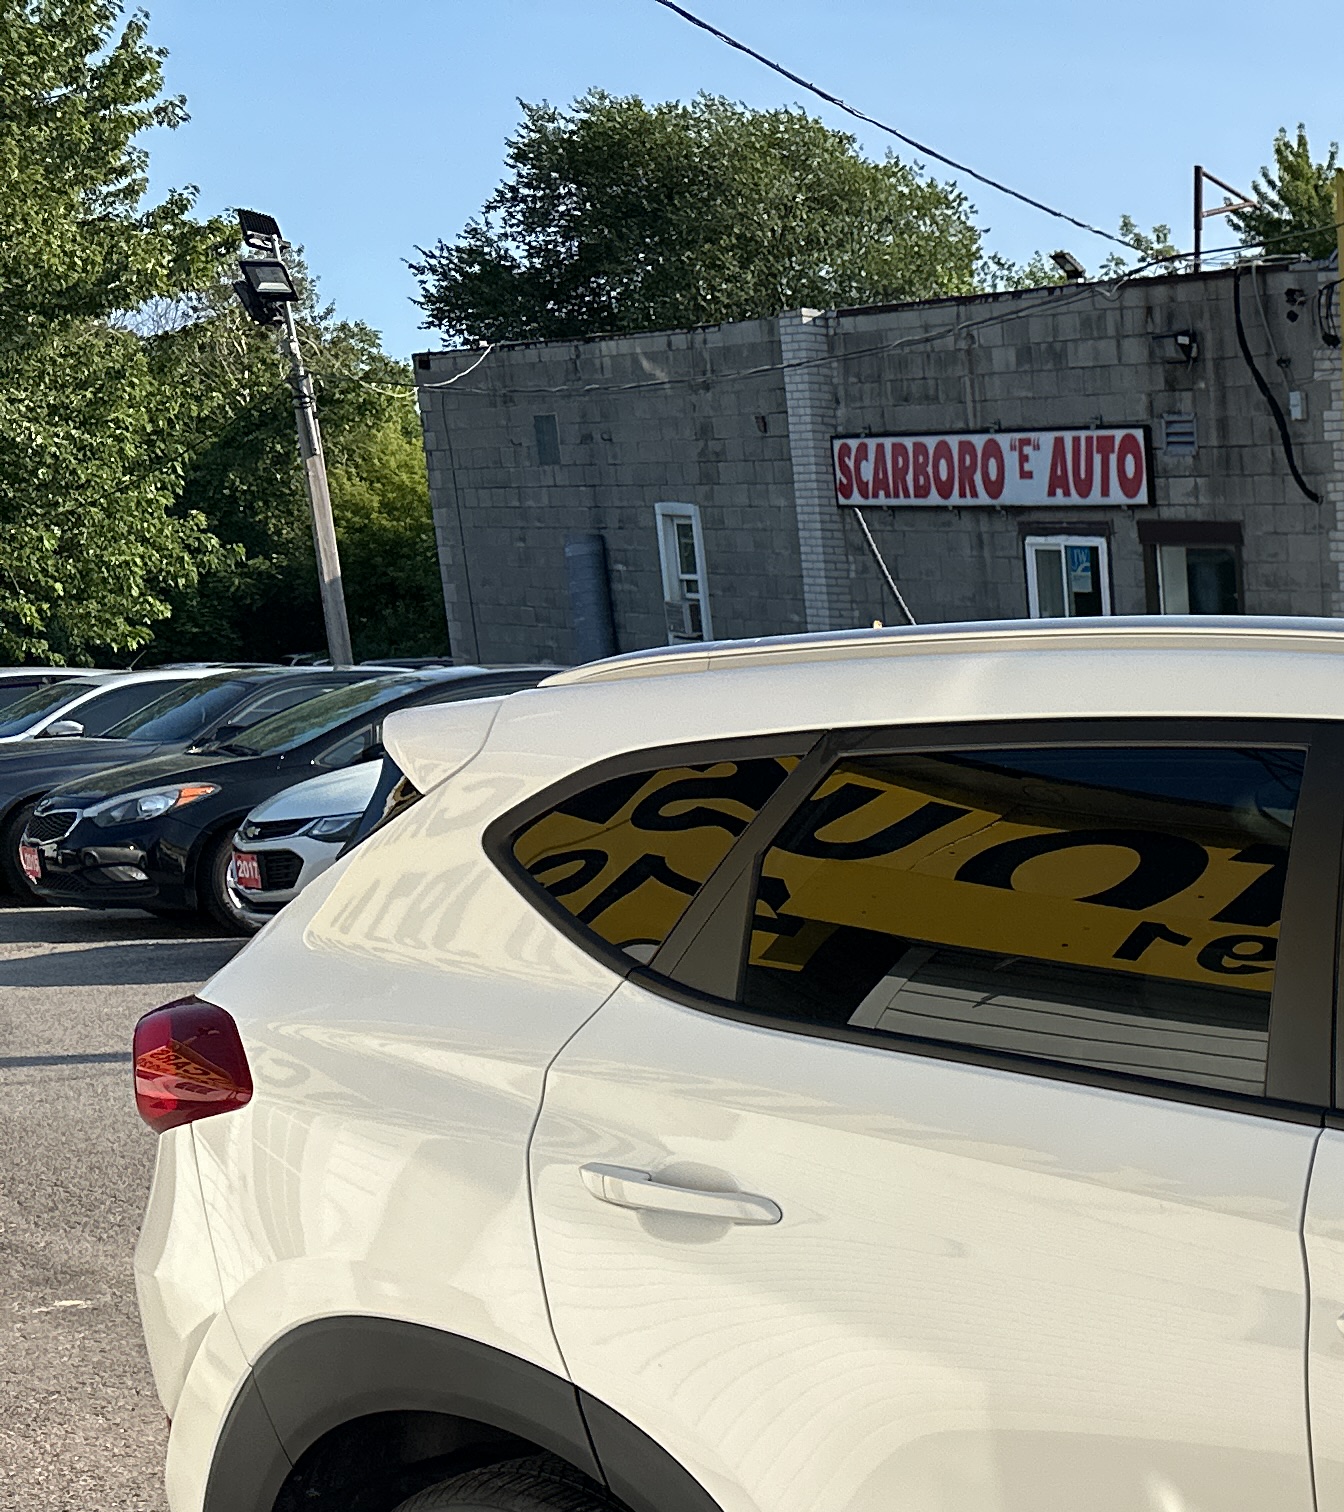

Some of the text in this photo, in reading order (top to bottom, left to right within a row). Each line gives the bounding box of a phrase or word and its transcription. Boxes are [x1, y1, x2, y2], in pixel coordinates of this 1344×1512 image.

[836, 437, 1006, 501] SCARBORO
[1047, 432, 1143, 500] AUTO
[237, 859, 258, 879] 2017
